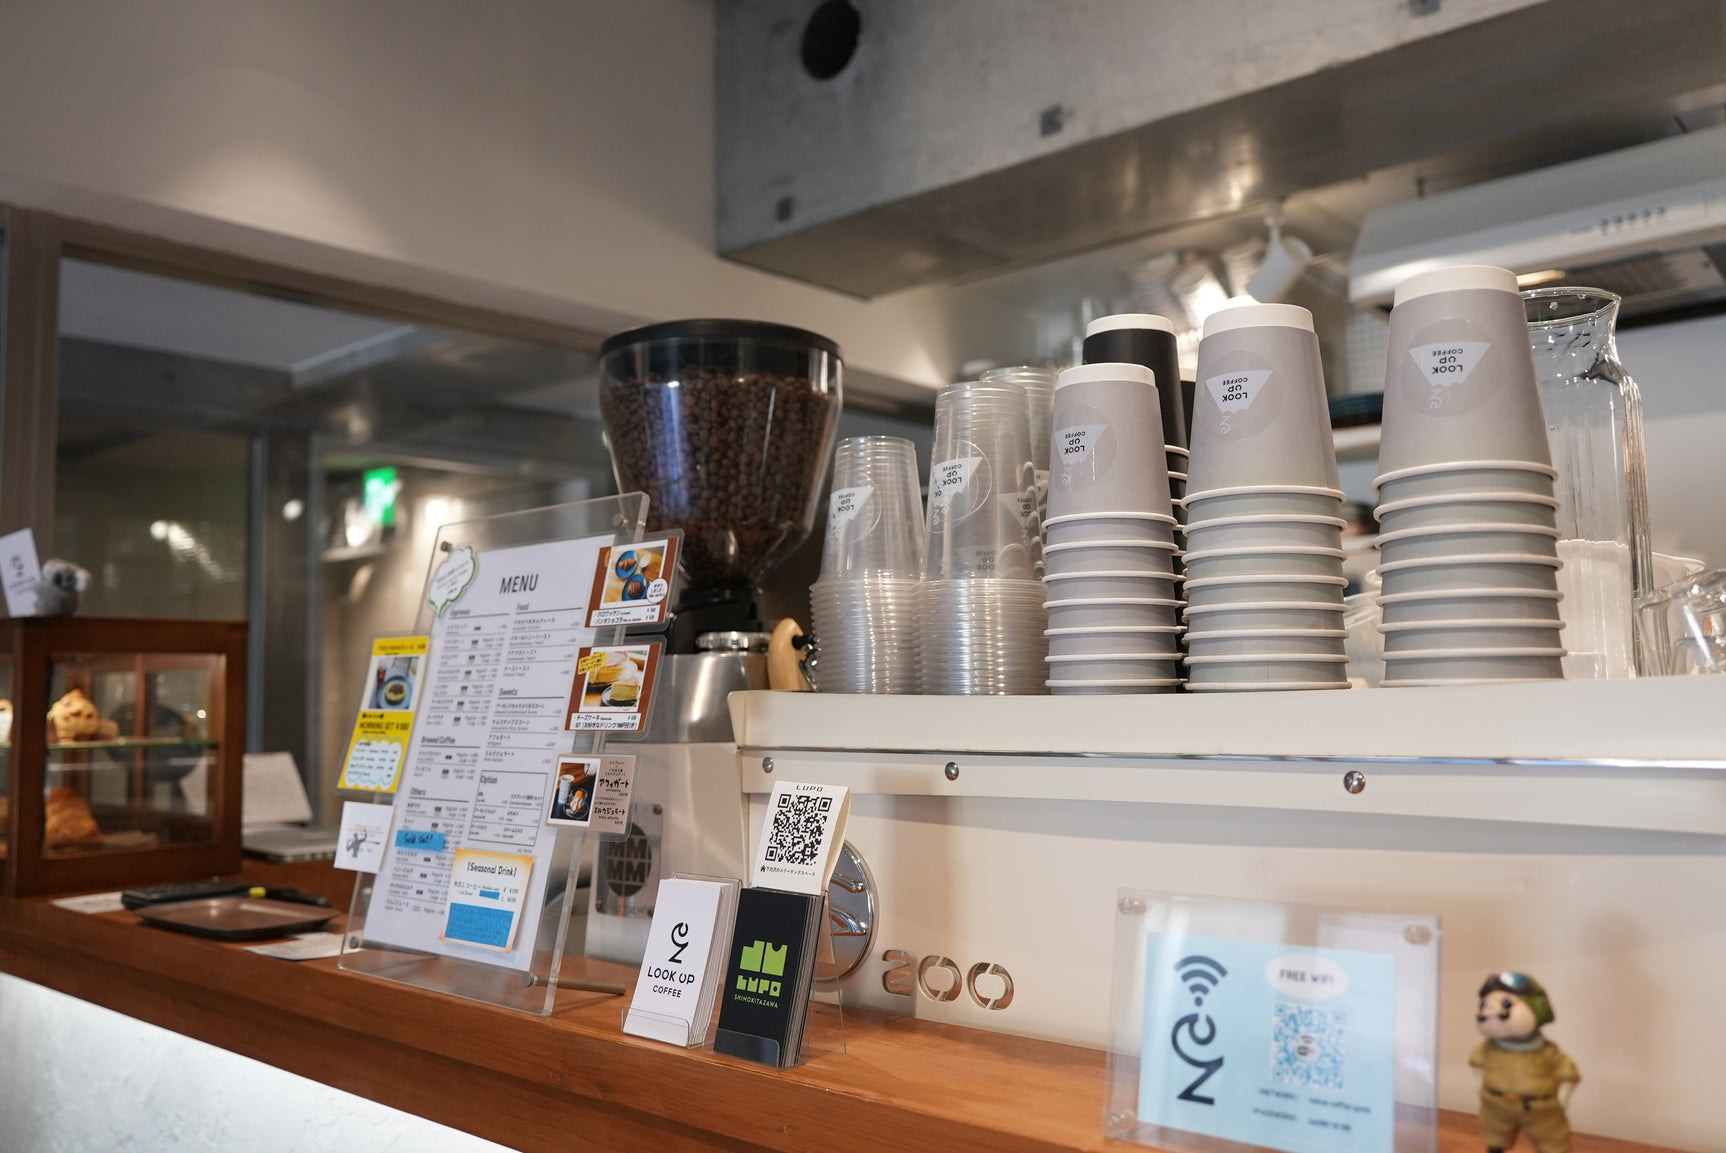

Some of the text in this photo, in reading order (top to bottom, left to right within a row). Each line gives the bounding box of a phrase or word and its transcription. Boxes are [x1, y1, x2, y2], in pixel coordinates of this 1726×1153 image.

[1439, 356, 1456, 364] UP
[1432, 364, 1462, 374] LOOK
[1222, 377, 1248, 385] COFFEE
[1222, 392, 1248, 402] LOOK
[1064, 445, 1084, 454] LOOK
[943, 477, 962, 486] LOOK
[499, 573, 539, 594] MENU
[480, 776, 498, 784] Option
[600, 778, 629, 788] アフォガート
[410, 788, 426, 796] Others
[766, 866, 816, 876] 下北沢のコワーキングスペース
[648, 967, 695, 985] LOOK UP
[1280, 969, 1307, 982] FREE
[653, 985, 682, 997] COFFEE
[736, 975, 781, 997] LUPO
[734, 994, 778, 1008] SHIMOKITAZAWA
